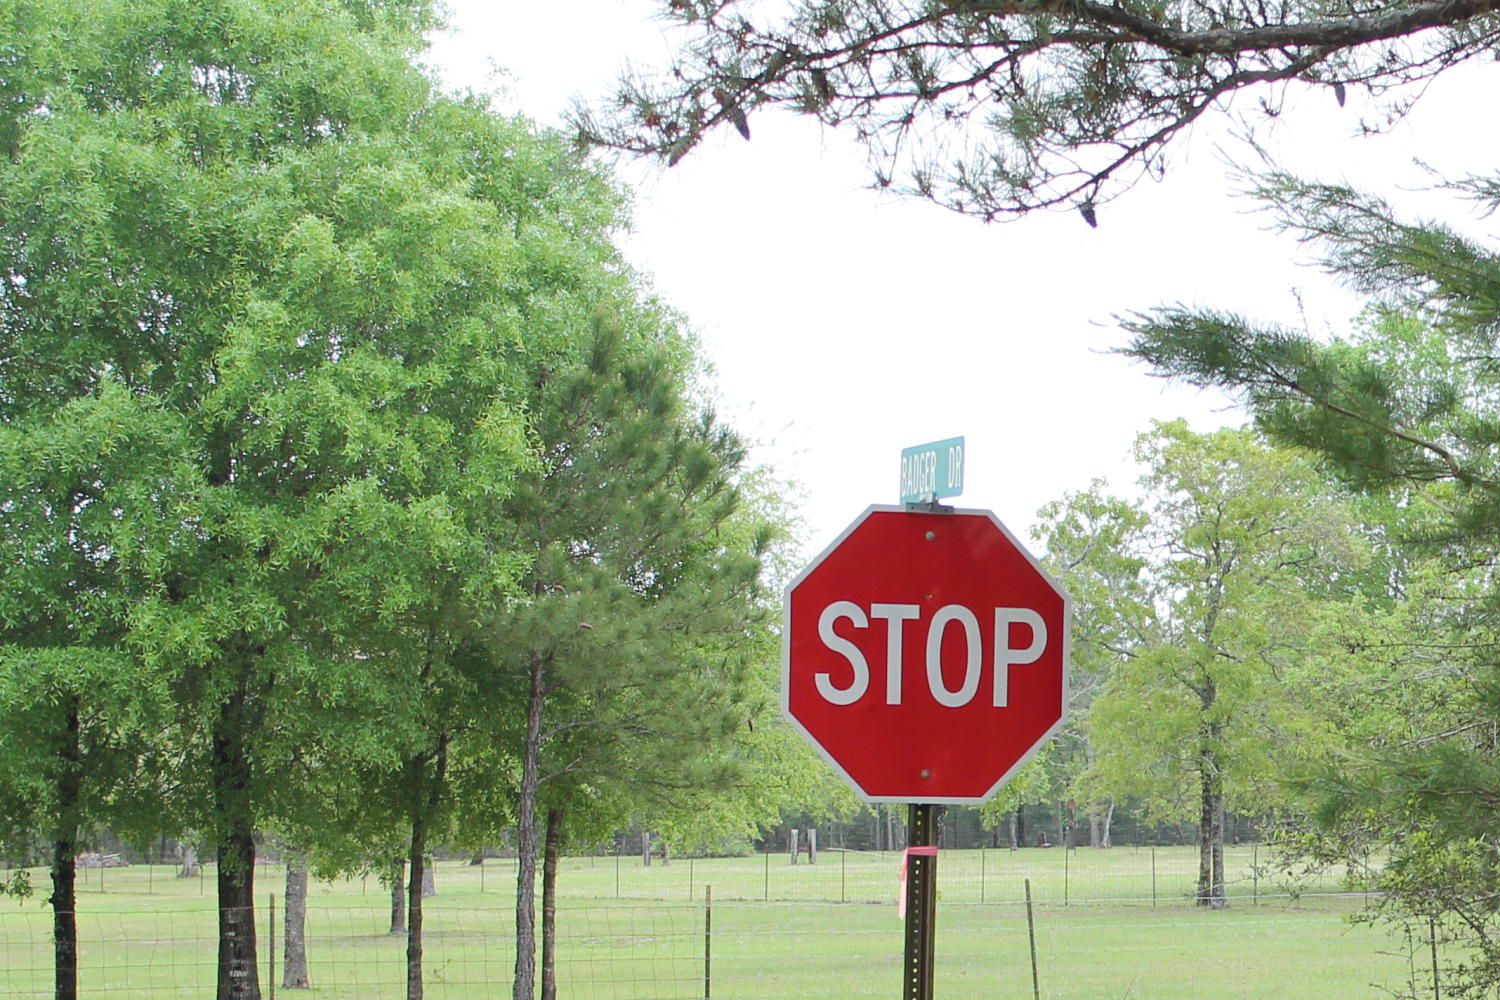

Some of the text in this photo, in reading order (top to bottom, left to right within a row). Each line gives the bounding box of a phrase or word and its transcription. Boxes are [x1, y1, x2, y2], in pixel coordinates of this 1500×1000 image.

[902, 445, 962, 497] BADGER DR
[814, 600, 1048, 708] STOP
